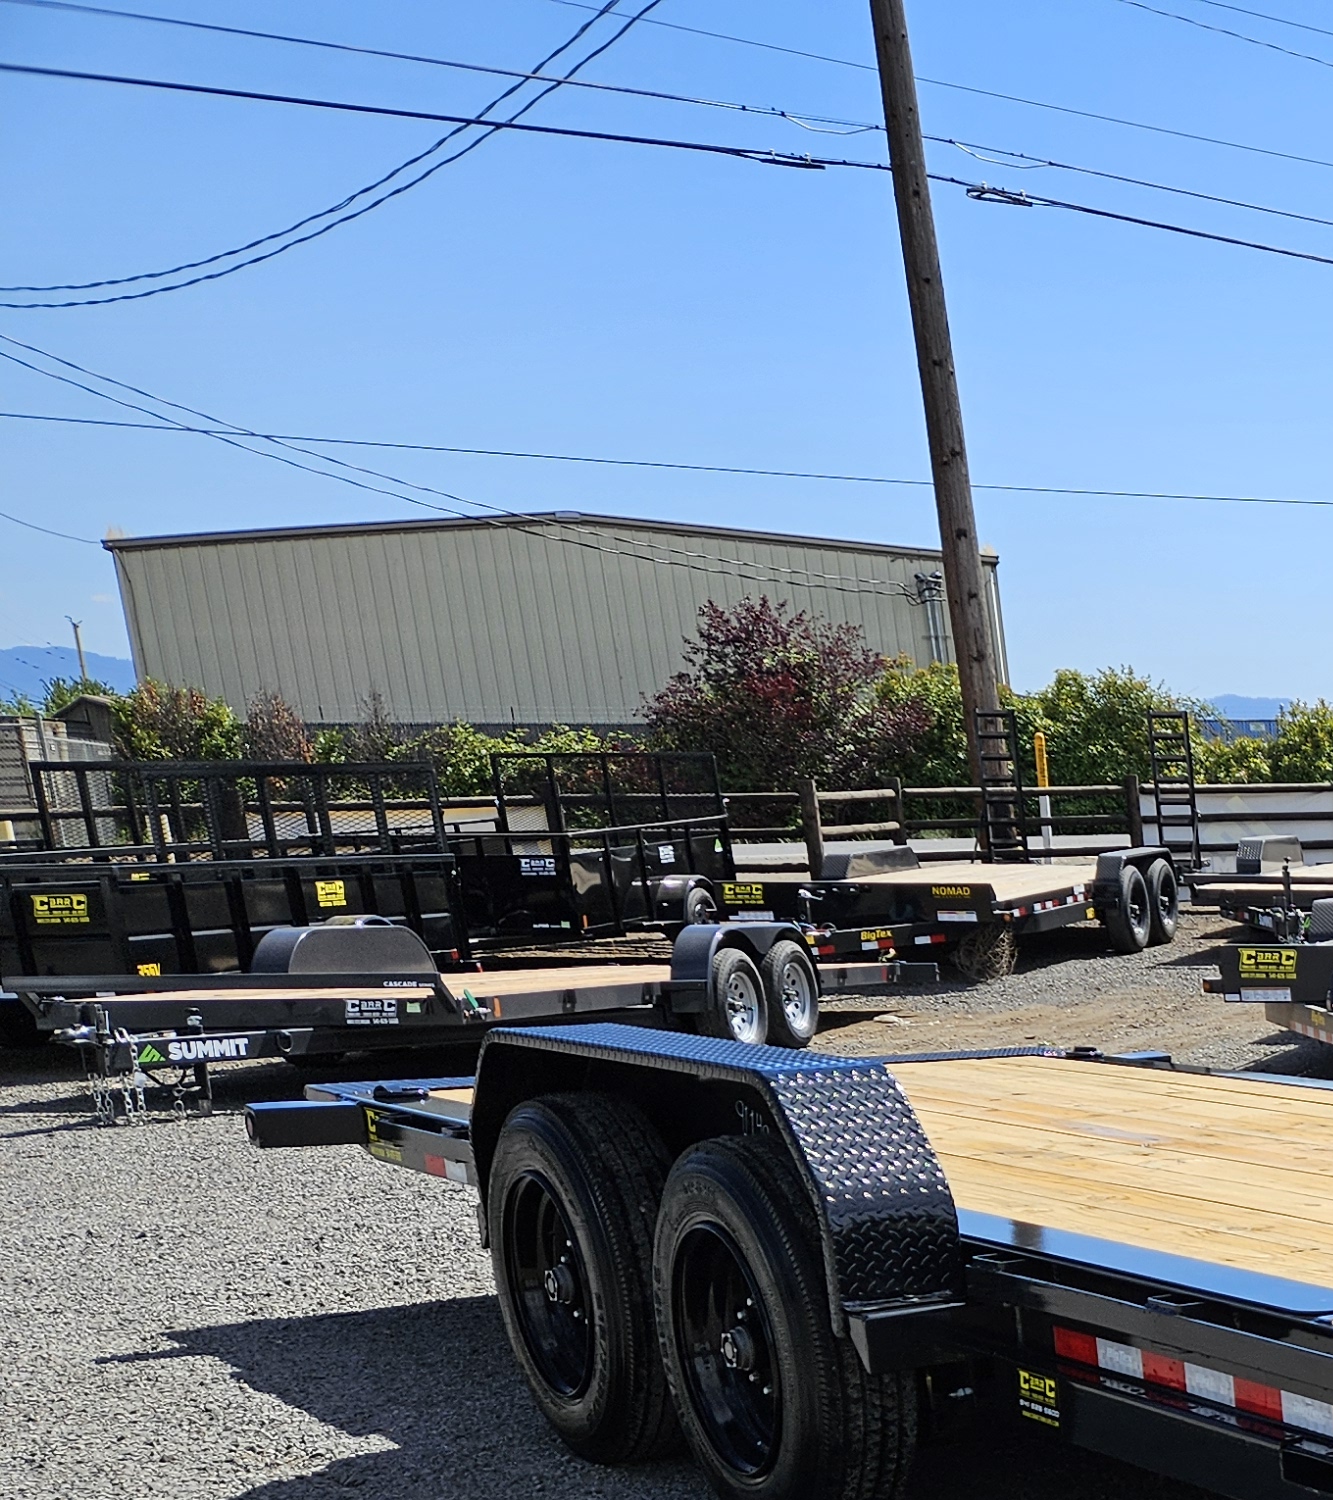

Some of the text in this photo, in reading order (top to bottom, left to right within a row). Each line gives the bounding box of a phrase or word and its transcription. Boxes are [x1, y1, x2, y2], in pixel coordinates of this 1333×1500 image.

[932, 886, 971, 896] NOMAD
[1242, 950, 1256, 964] C
[1280, 951, 1295, 965] C
[168, 1037, 249, 1061] SUMMIT
[1019, 1370, 1029, 1390] C
[1045, 1378, 1056, 1398] C
